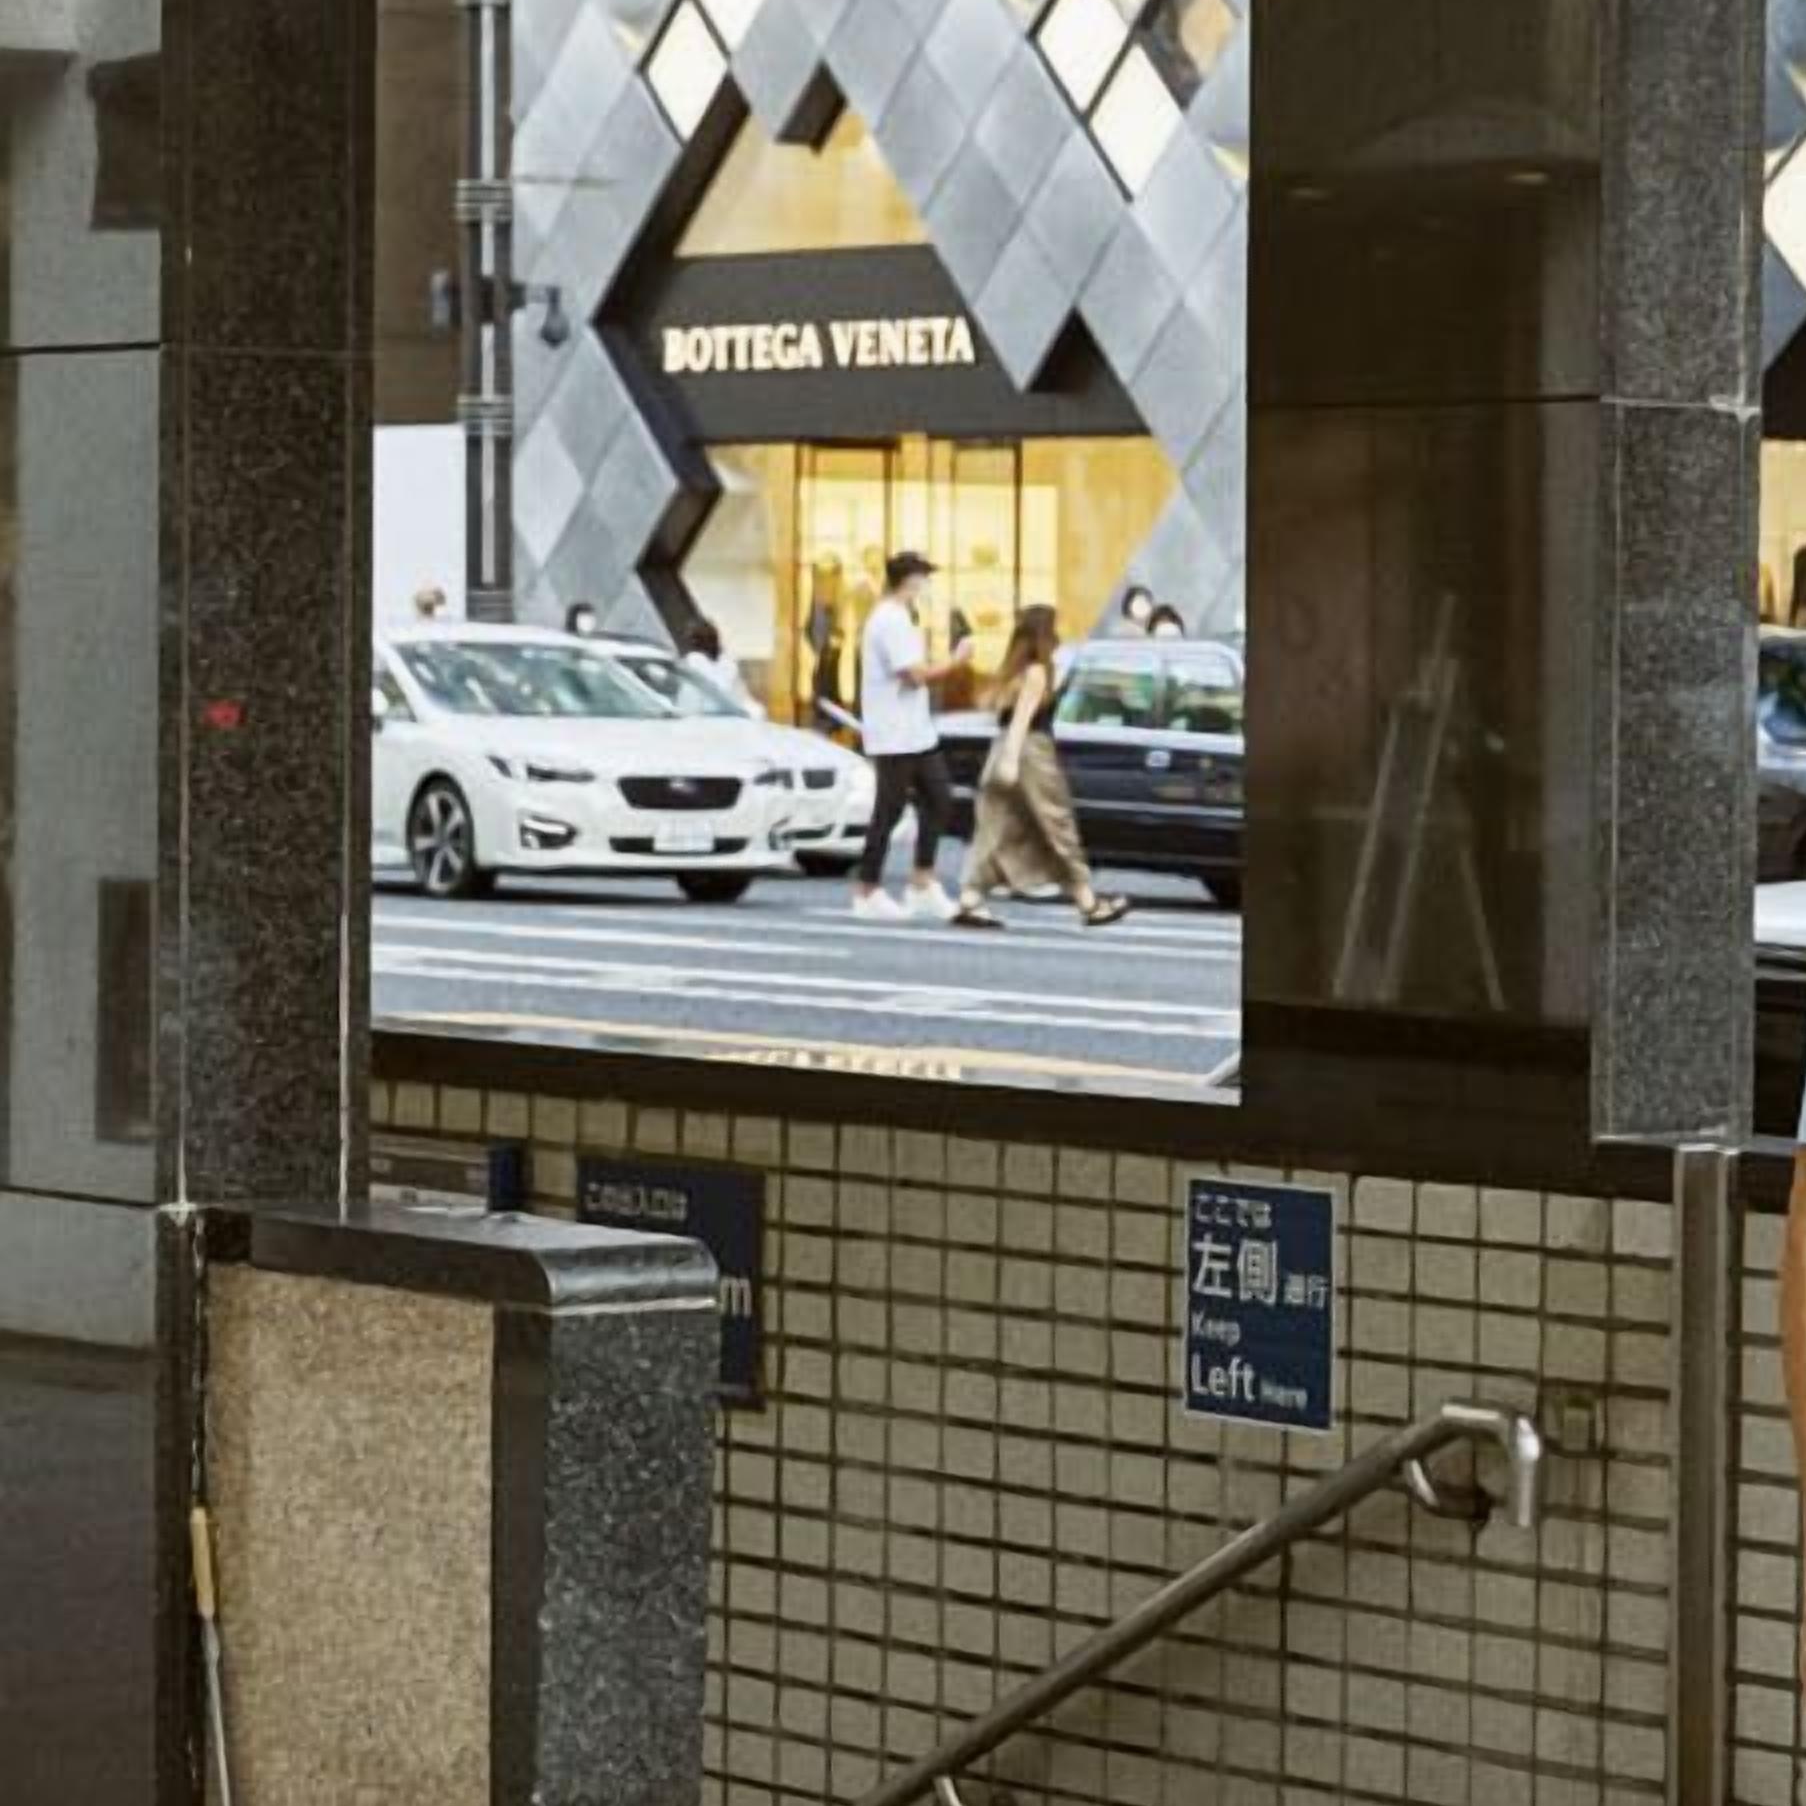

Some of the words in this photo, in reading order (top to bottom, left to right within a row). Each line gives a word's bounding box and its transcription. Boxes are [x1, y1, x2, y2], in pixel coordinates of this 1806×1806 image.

[662, 322, 824, 372] BOTTEGA
[829, 316, 975, 367] VENETA
[1191, 1352, 1255, 1404] Left
